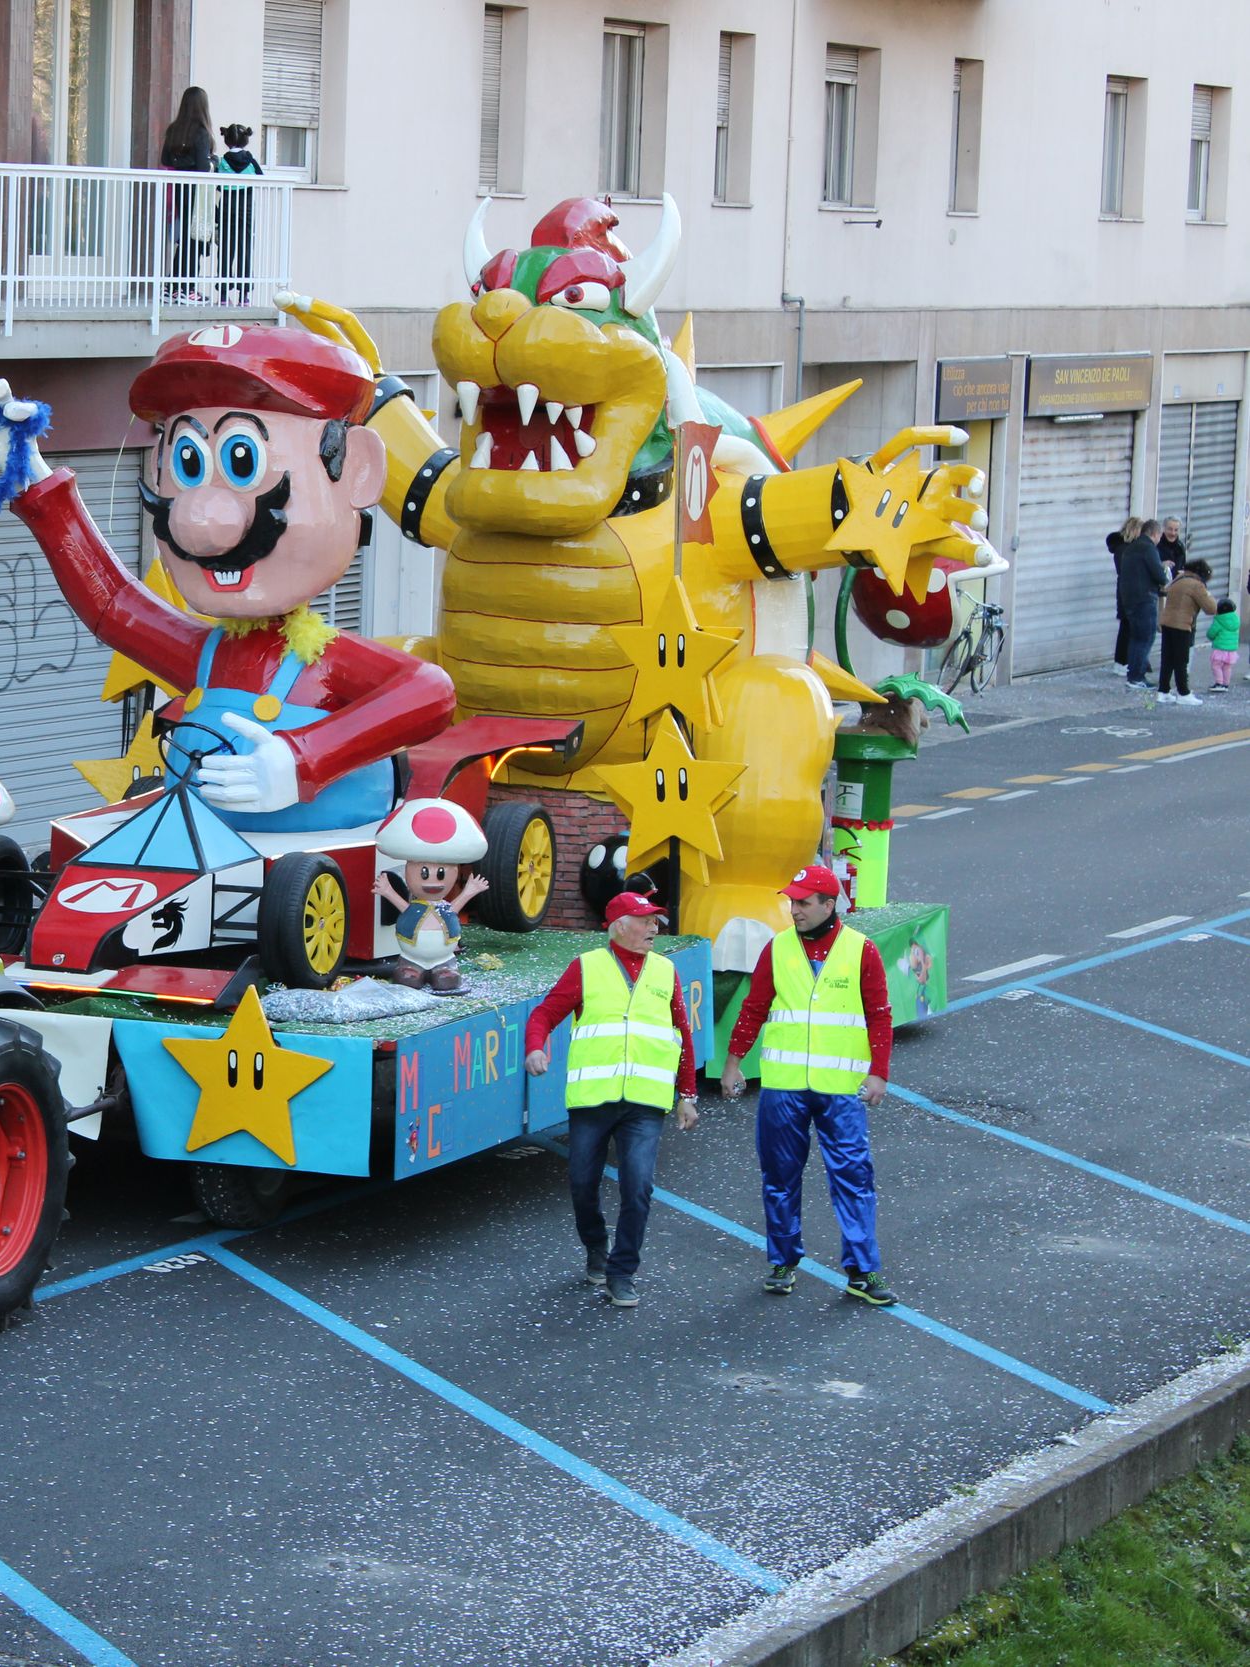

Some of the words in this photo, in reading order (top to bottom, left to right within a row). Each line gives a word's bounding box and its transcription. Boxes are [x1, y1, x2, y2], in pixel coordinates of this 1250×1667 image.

[1054, 368, 1069, 385] SAN
[1070, 368, 1101, 385] VINCENZO
[1102, 367, 1111, 383] DE
[1111, 366, 1131, 382] PAOLI
[964, 382, 975, 396] che
[976, 382, 997, 396] ancora
[966, 400, 978, 416] per
[63, 881, 144, 908] M
